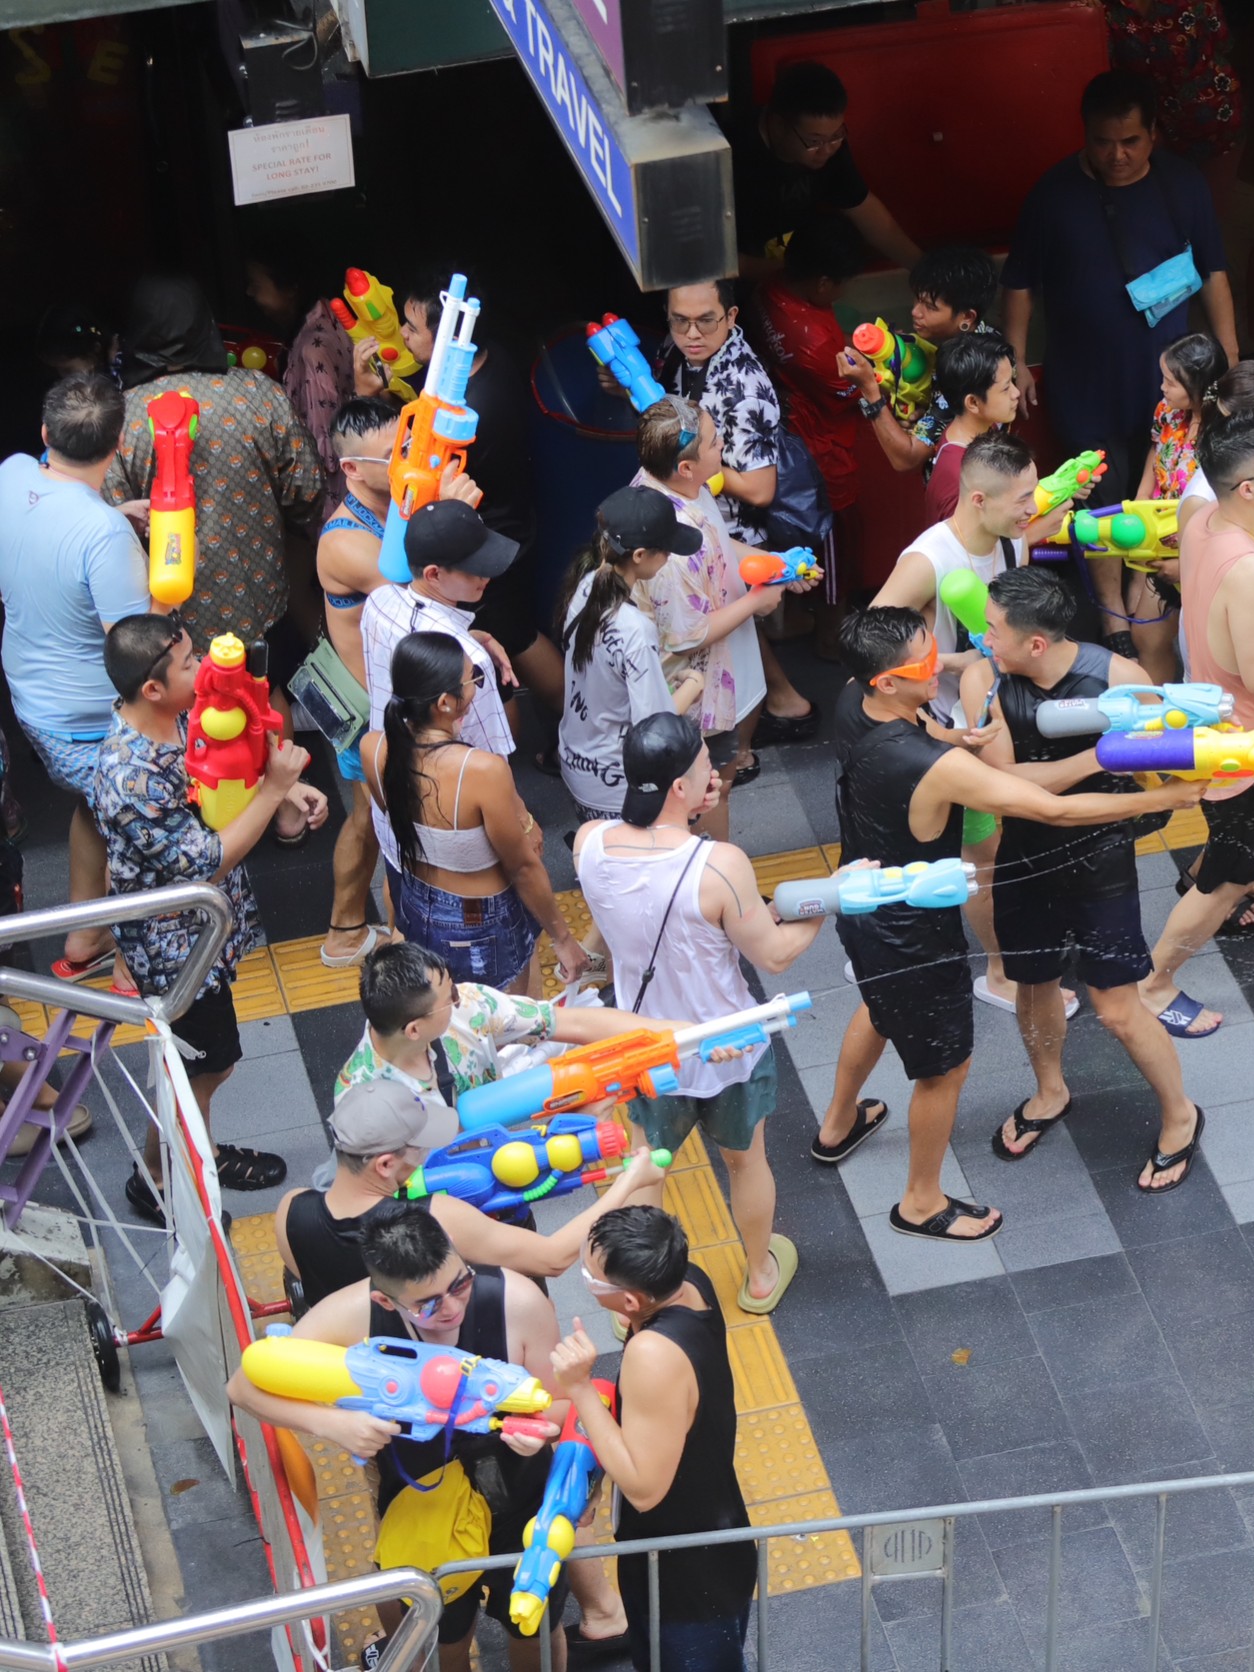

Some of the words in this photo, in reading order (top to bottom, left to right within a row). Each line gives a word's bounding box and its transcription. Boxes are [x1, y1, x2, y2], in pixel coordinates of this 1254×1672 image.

[521, 0, 622, 218] TRAVEL
[252, 160, 287, 172] SPECIAL
[289, 155, 312, 167] RATE
[313, 152, 332, 162] FOR
[266, 171, 292, 181] LONG
[294, 166, 319, 177] STAY!
